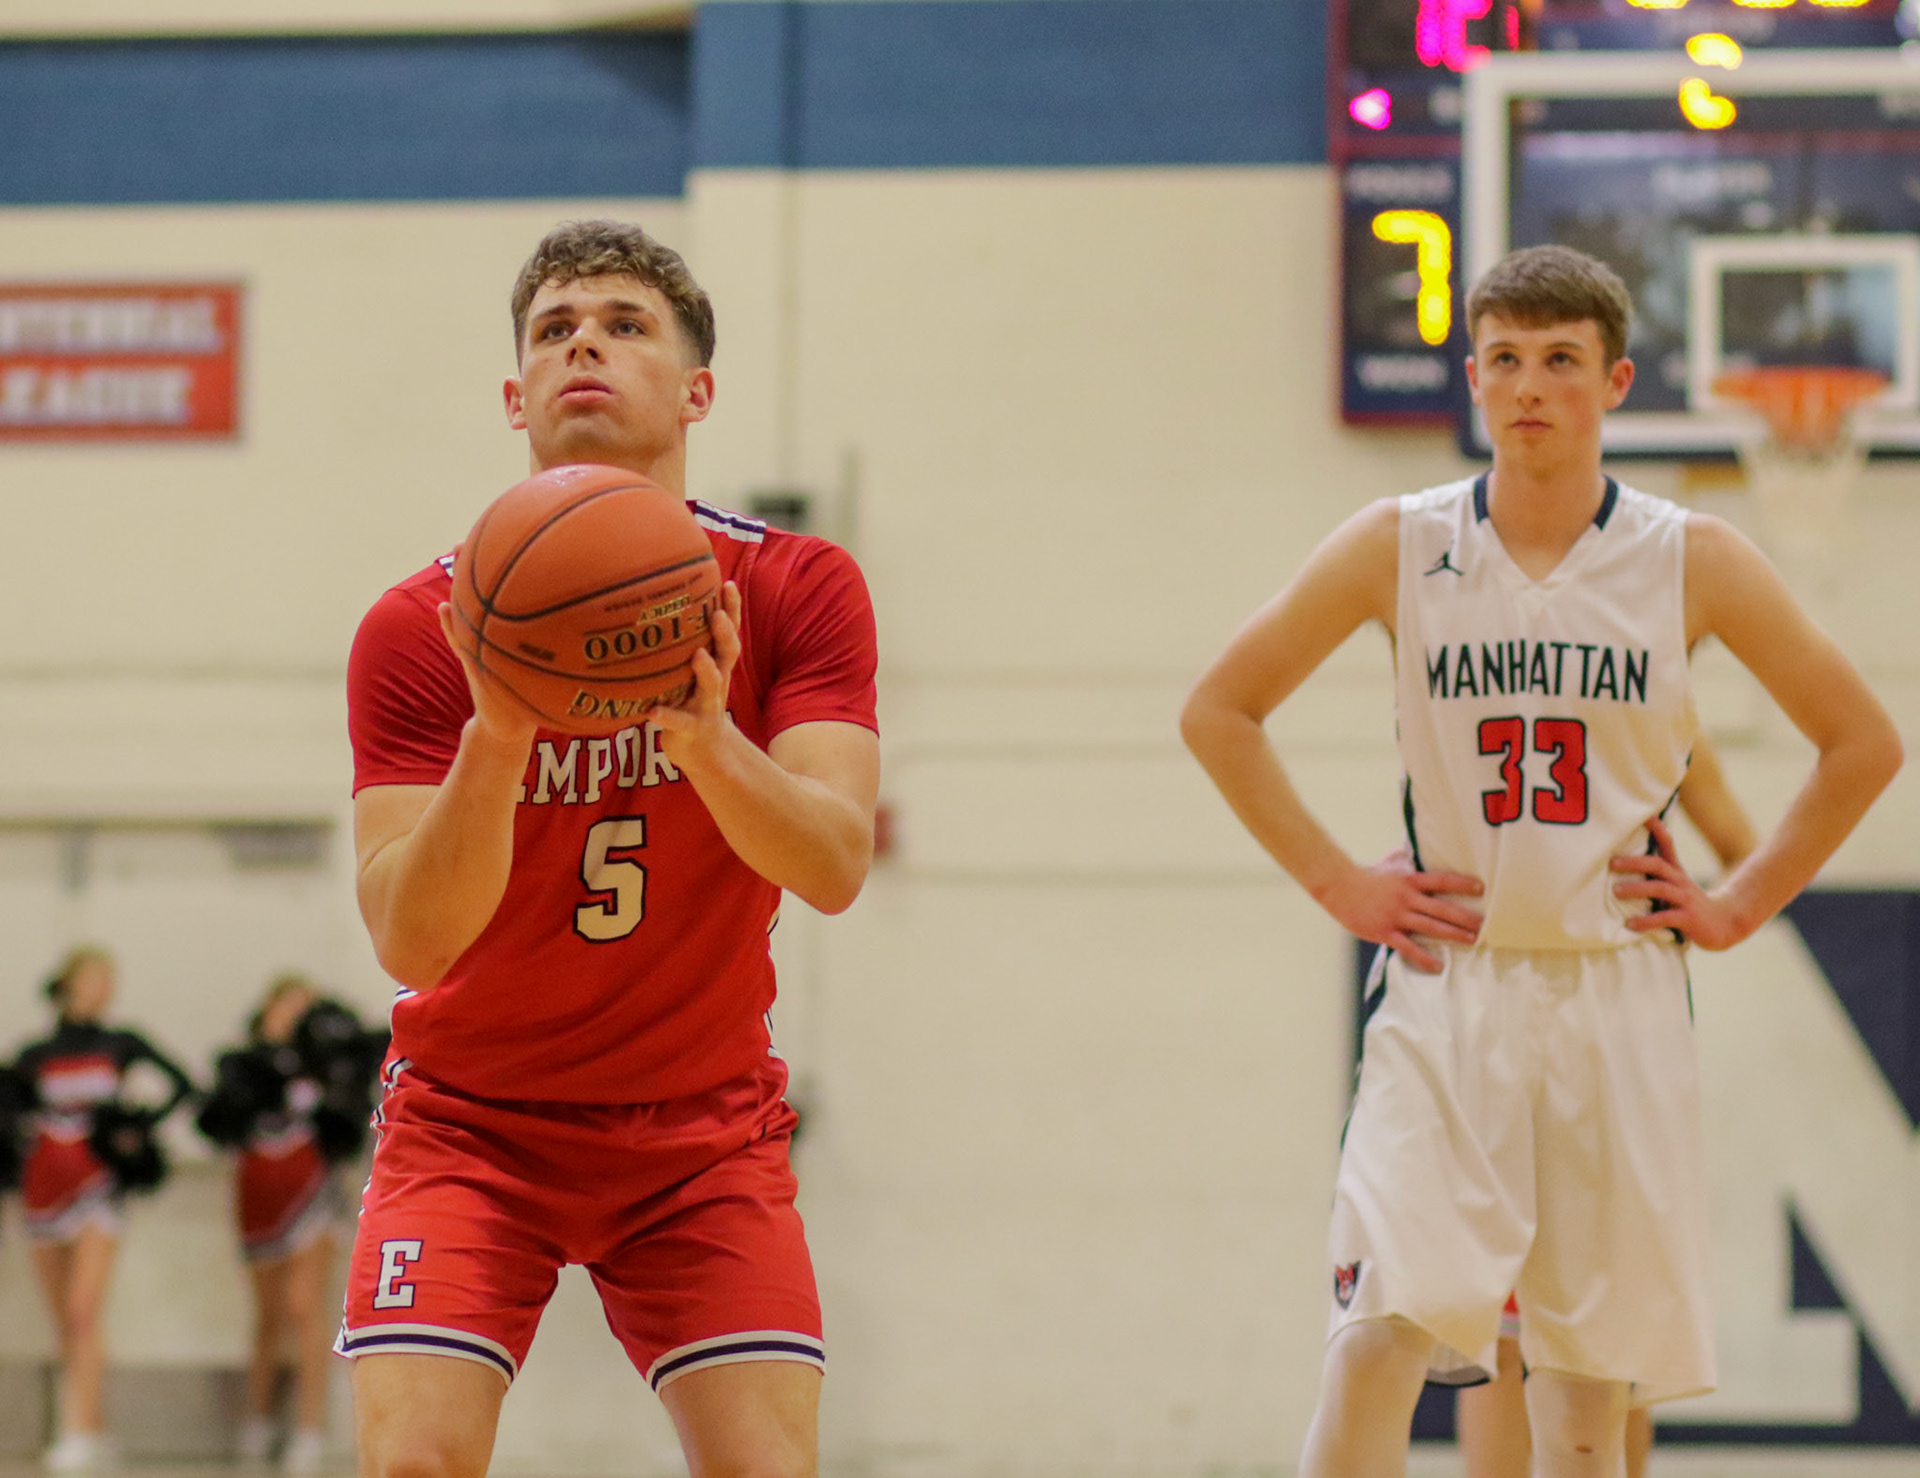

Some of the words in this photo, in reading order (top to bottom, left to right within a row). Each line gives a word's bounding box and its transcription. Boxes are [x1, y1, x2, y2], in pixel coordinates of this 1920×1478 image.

[1373, 211, 1451, 344] 7
[1425, 638, 1650, 704] MANHATTAN
[1477, 715, 1589, 827] 33
[573, 814, 647, 944] 5
[372, 1238, 424, 1311] E
